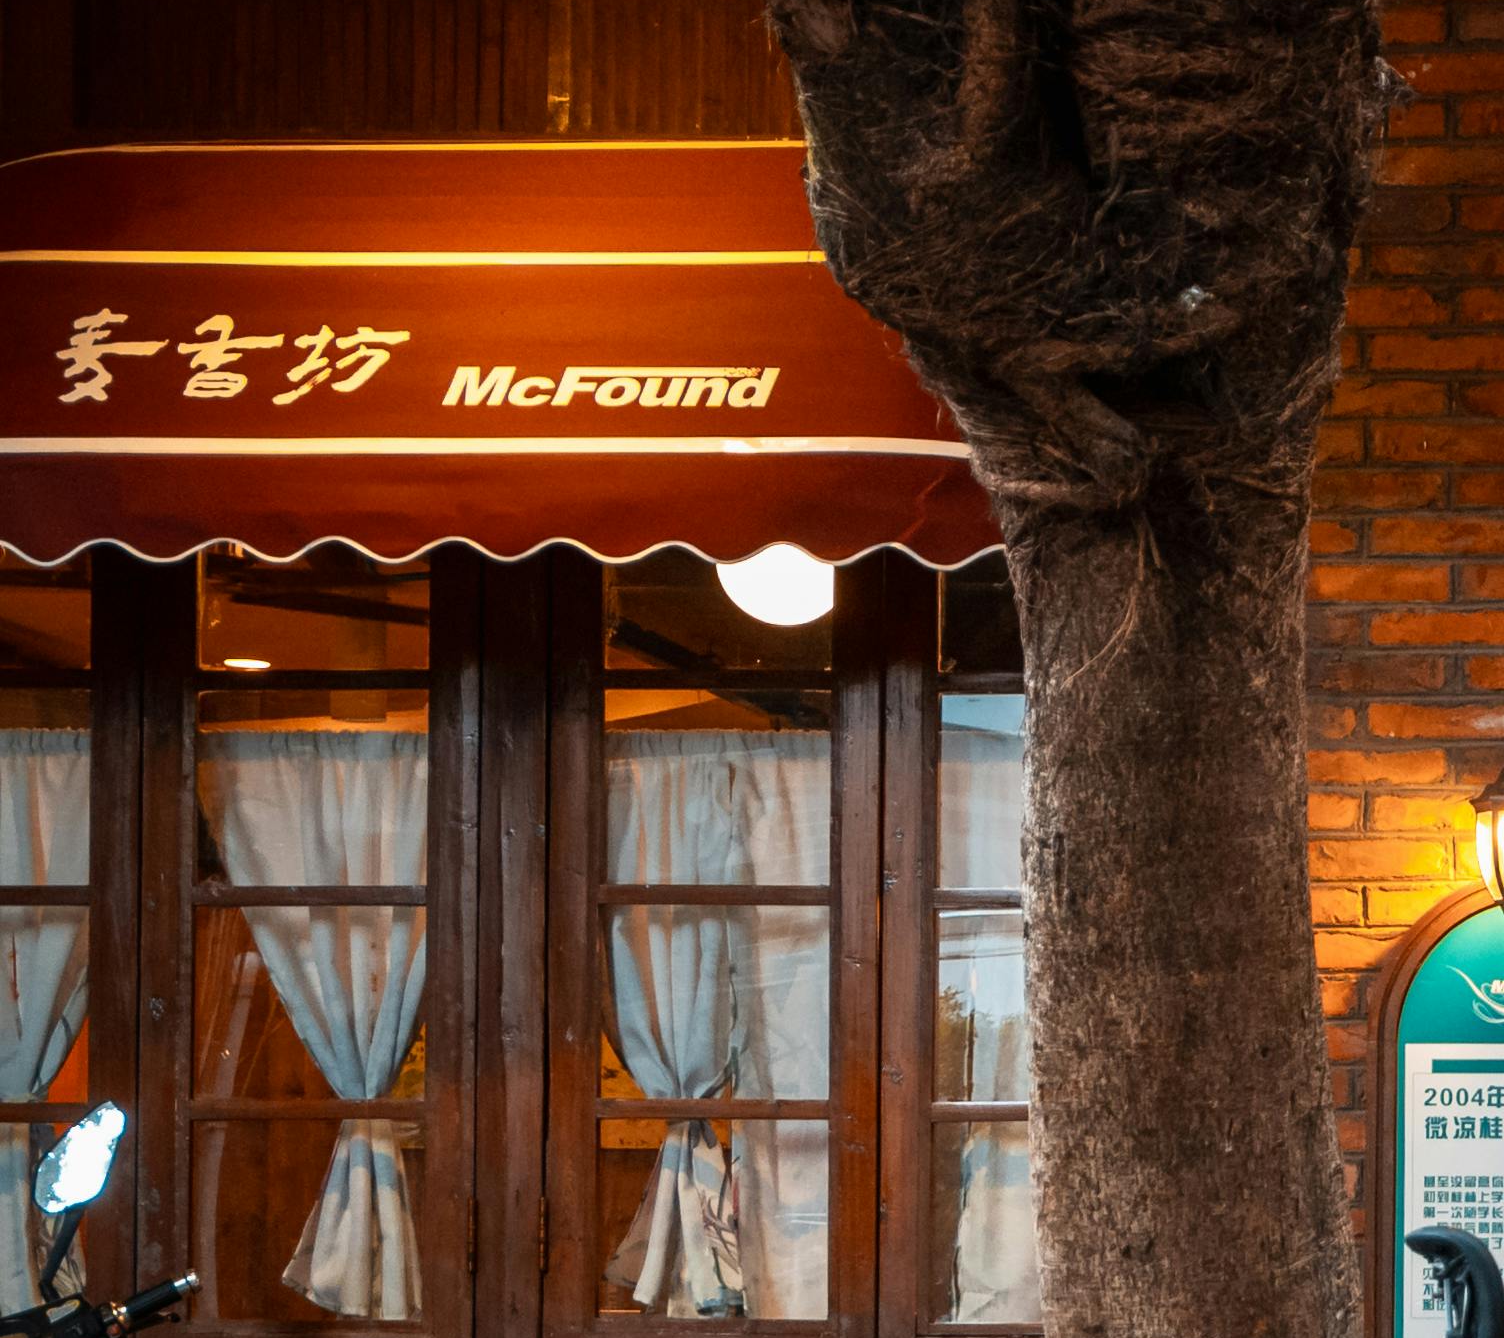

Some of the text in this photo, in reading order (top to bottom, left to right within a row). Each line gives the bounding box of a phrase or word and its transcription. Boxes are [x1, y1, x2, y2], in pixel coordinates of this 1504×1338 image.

[56, 308, 411, 405] 麦香坊
[442, 367, 780, 408] McFound
